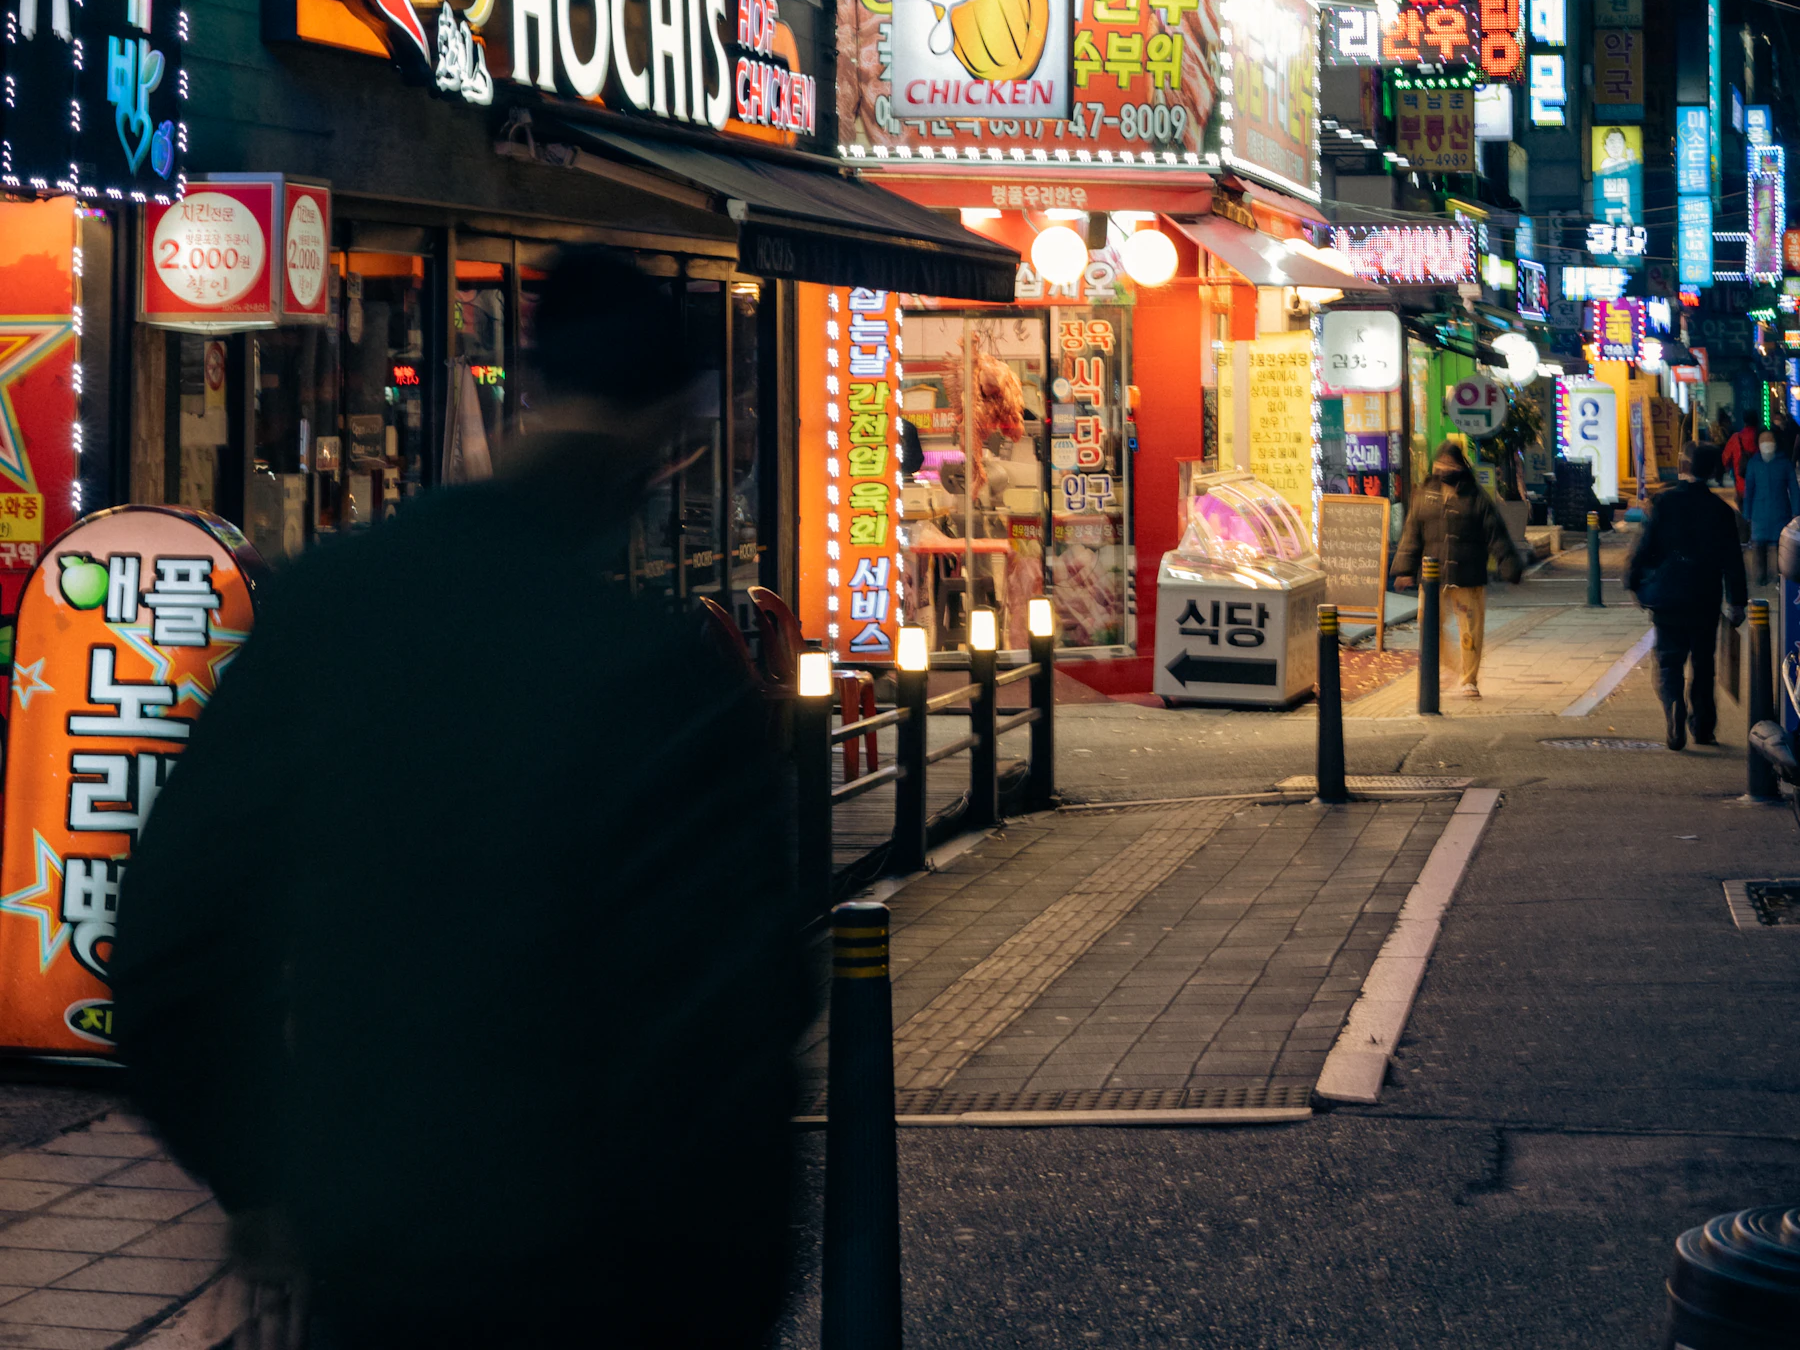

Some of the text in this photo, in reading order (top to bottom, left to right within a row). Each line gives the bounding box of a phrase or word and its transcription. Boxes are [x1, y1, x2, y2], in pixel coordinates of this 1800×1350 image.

[1073, 30, 1185, 90] 수부위
[1601, 31, 1633, 101] 약국
[736, 56, 816, 137] CHICKEN
[904, 79, 1055, 106] CHICKEN
[1399, 114, 1471, 152] 부동산
[1400, 153, 1468, 167] 46-4989
[991, 185, 1088, 206] 명품우리한우
[1060, 320, 1115, 352] 정육
[1068, 358, 1106, 473] 식당
[1454, 382, 1498, 427] 약
[1579, 397, 1600, 441] CU
[0, 497, 38, 520] 화중
[1062, 474, 1114, 512] 입구
[848, 381, 892, 653] 간천엽 육회 서비스
[1176, 598, 1270, 648] 식당
